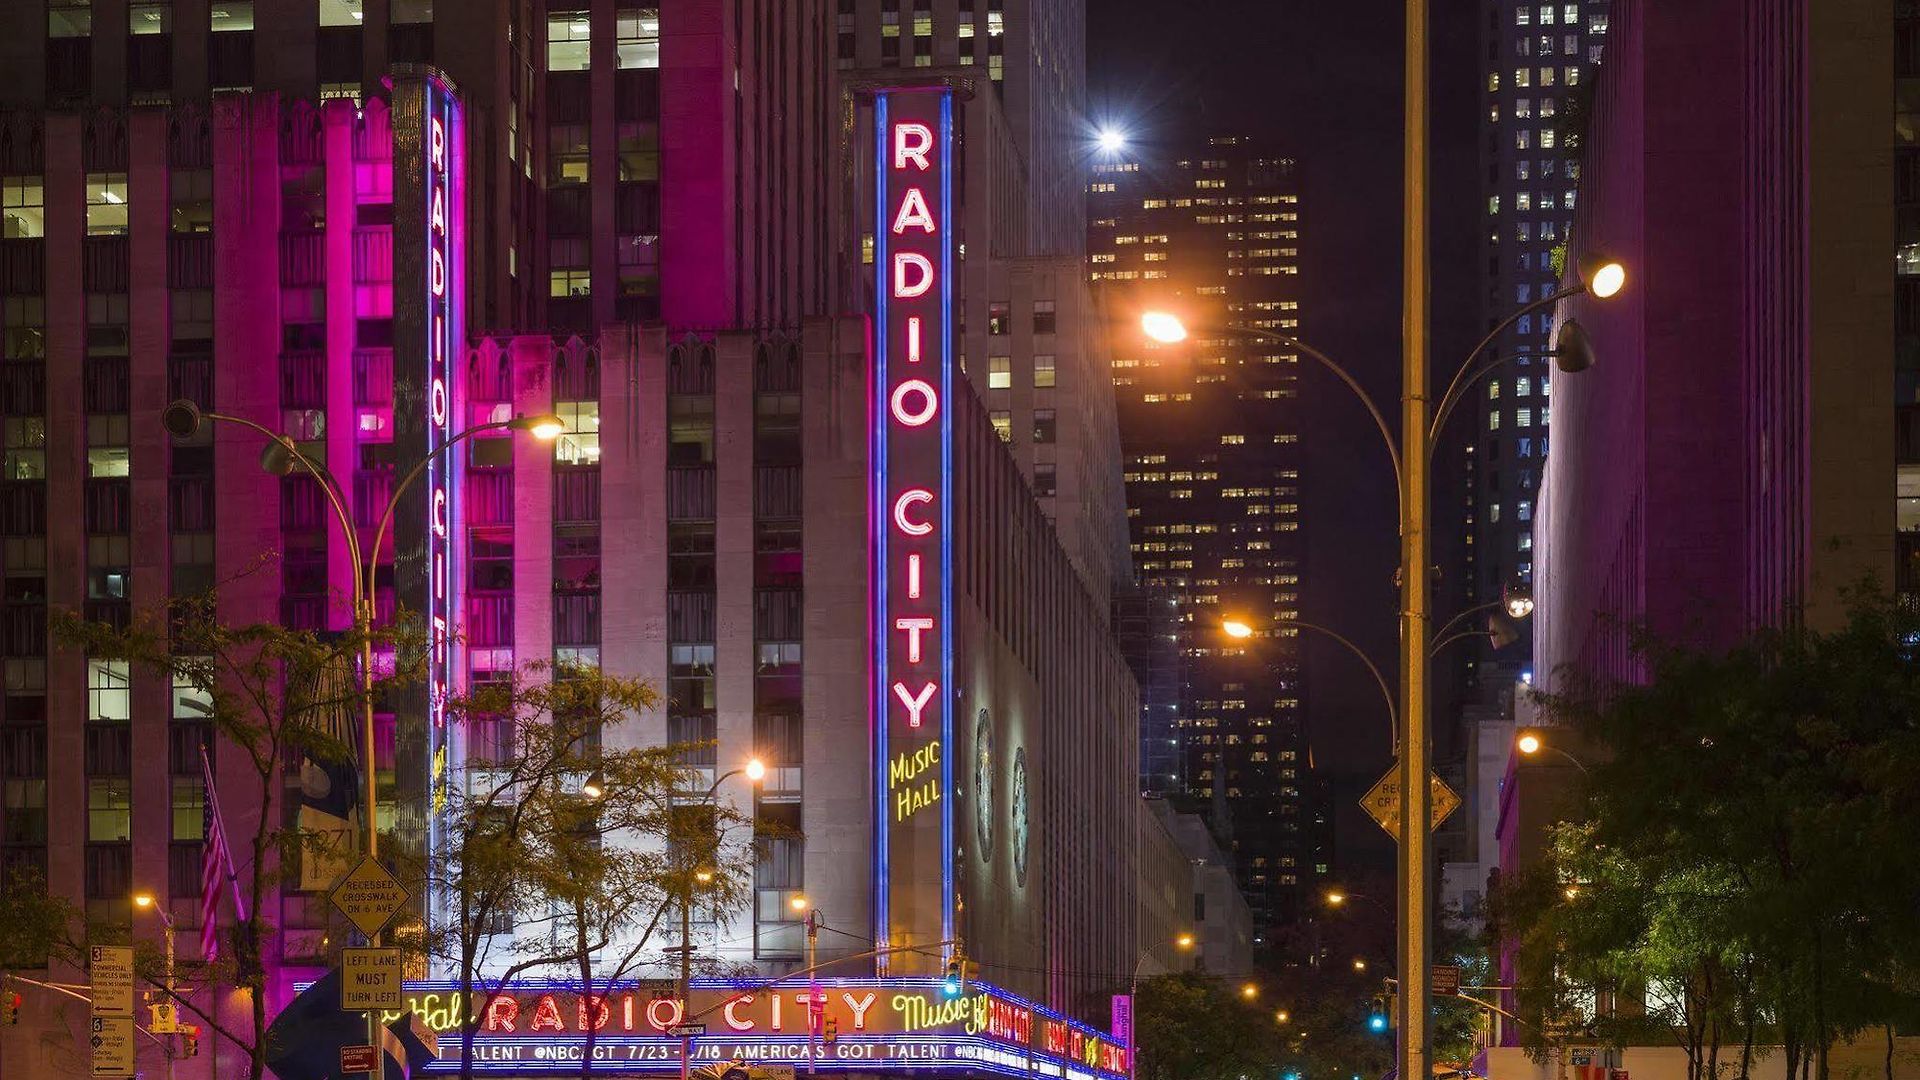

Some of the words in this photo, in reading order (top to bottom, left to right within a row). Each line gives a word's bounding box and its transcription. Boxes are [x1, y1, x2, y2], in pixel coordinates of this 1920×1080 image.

[431, 116, 446, 427] RADIO
[891, 123, 938, 427] RADIO
[432, 488, 447, 729] CITY
[893, 489, 938, 728] CITY
[346, 880, 394, 890] RECESSED
[342, 892, 398, 902] CROSSWALK
[376, 903, 394, 913] AVE
[346, 955, 369, 967] LEFT
[372, 955, 397, 967] LANE
[356, 972, 388, 986] MUST
[346, 992, 371, 1003] TURN
[375, 992, 397, 1002] LEFT
[488, 994, 683, 1032] RADIO
[724, 993, 876, 1031] CITY
[837, 1044, 874, 1059] GOT
[887, 1044, 947, 1059] TALENT
